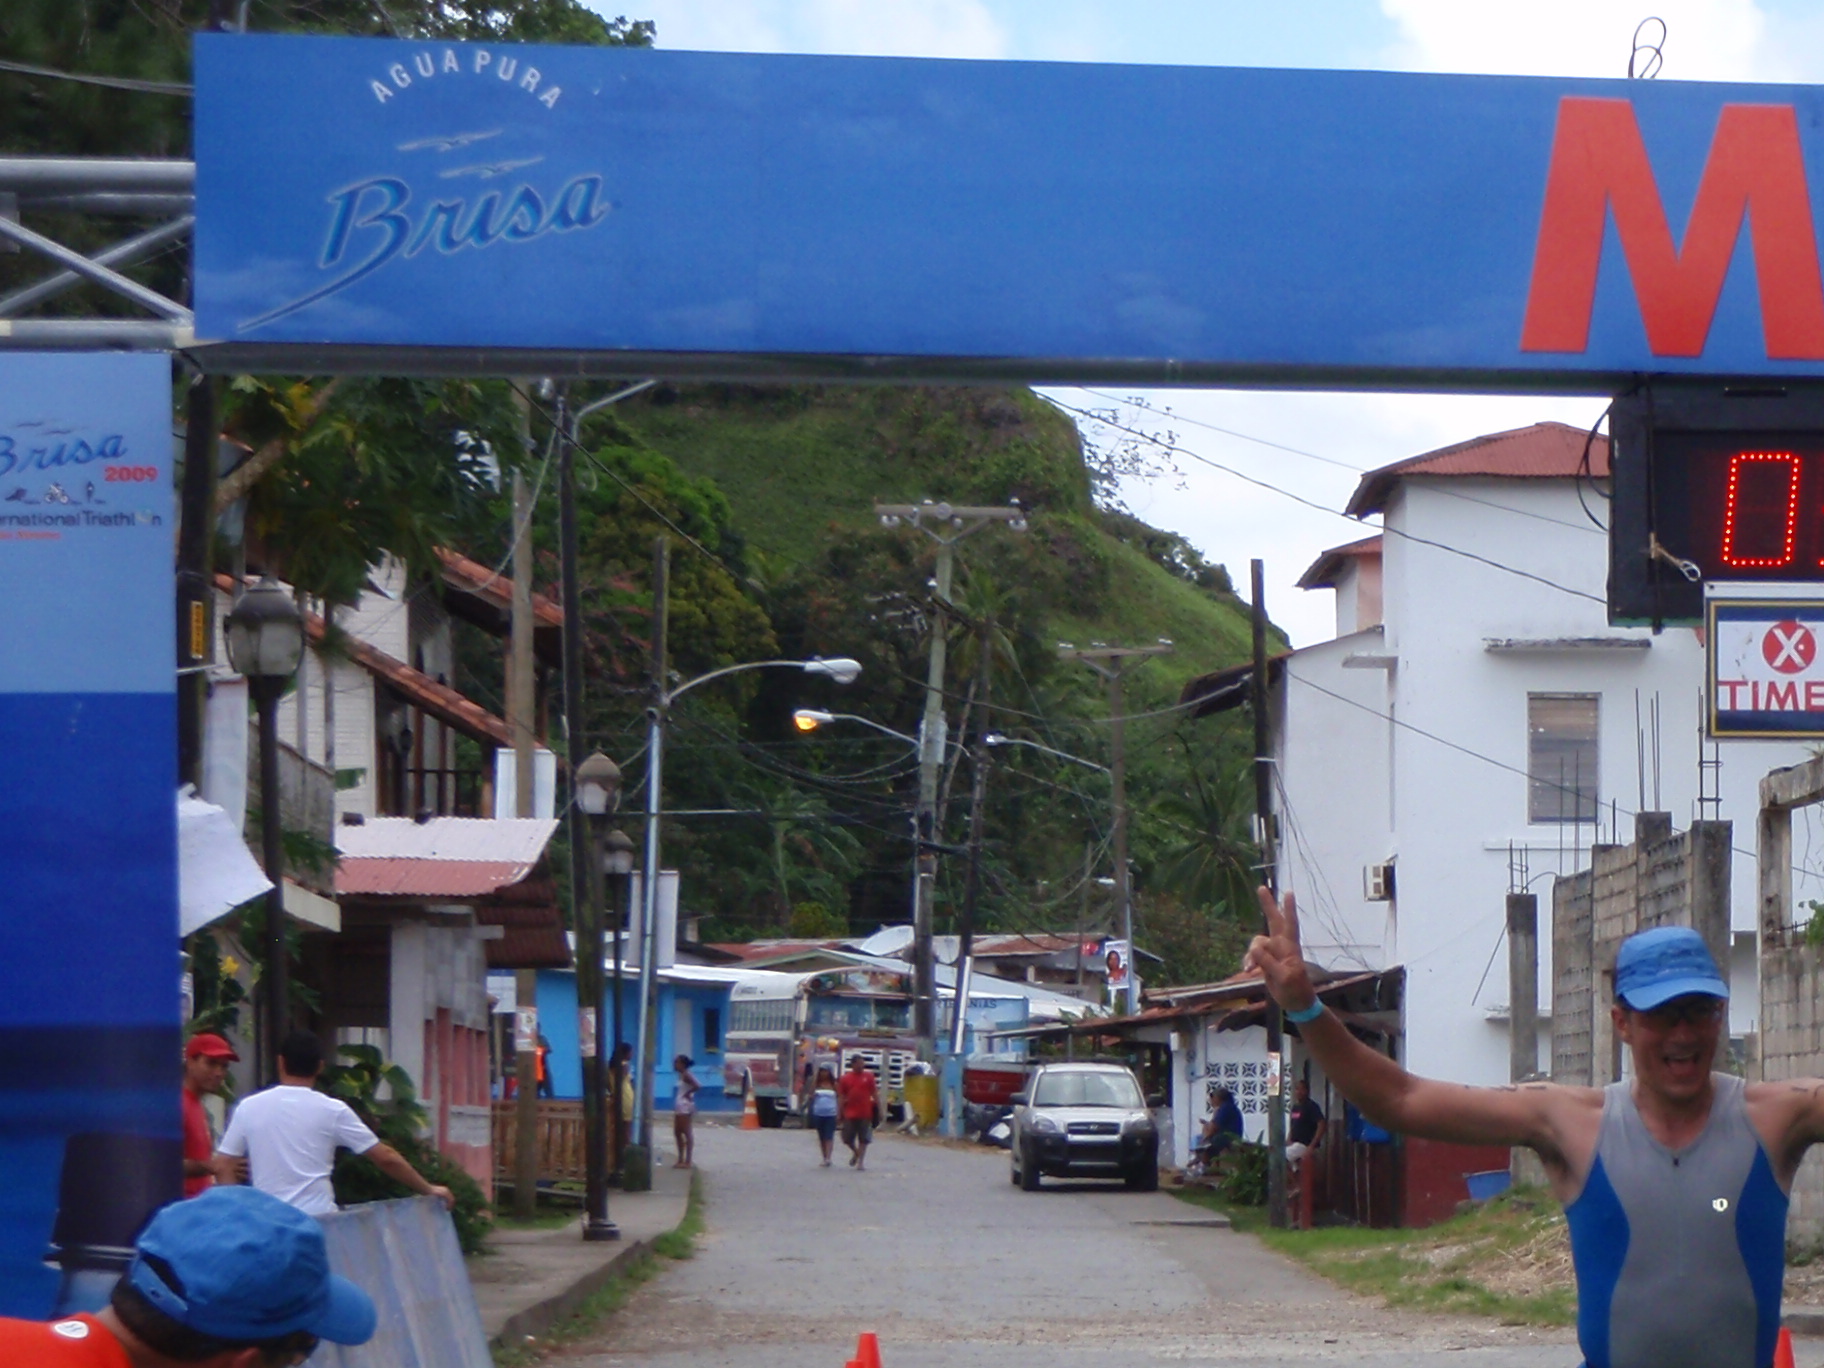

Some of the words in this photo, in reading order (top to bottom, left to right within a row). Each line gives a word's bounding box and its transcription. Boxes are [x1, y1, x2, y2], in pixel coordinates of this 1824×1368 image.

[370, 49, 460, 104] AGUA
[474, 49, 562, 109] PURA
[104, 465, 160, 482] 2009
[0, 512, 81, 527] rnational
